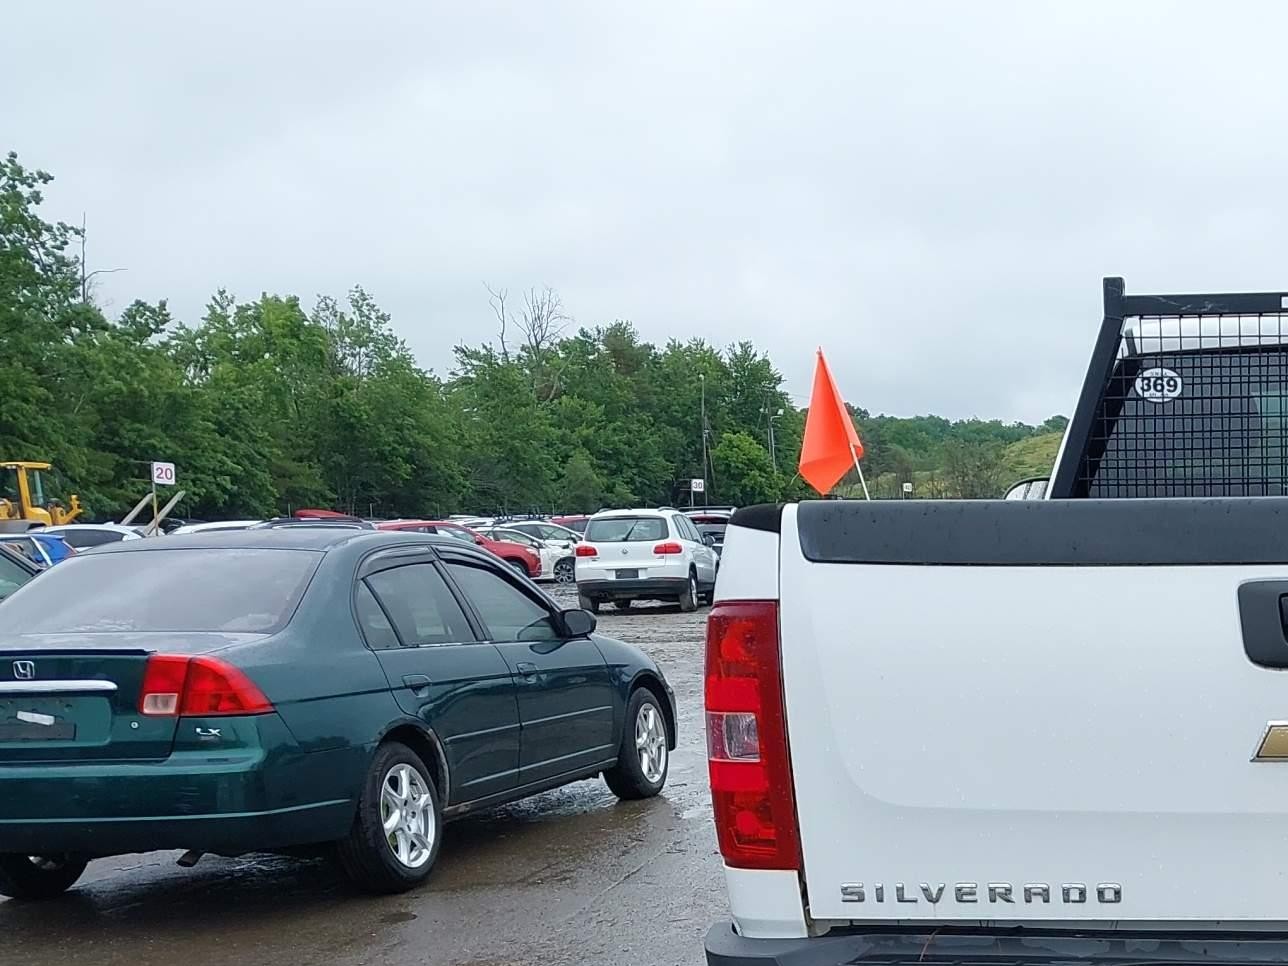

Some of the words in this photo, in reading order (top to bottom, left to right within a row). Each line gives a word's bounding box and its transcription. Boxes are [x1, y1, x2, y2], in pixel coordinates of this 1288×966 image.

[1140, 377, 1178, 393] 369
[155, 466, 173, 481] 20
[693, 481, 703, 489] 30
[195, 727, 222, 737] LX
[839, 882, 1123, 904] SILVERADO
